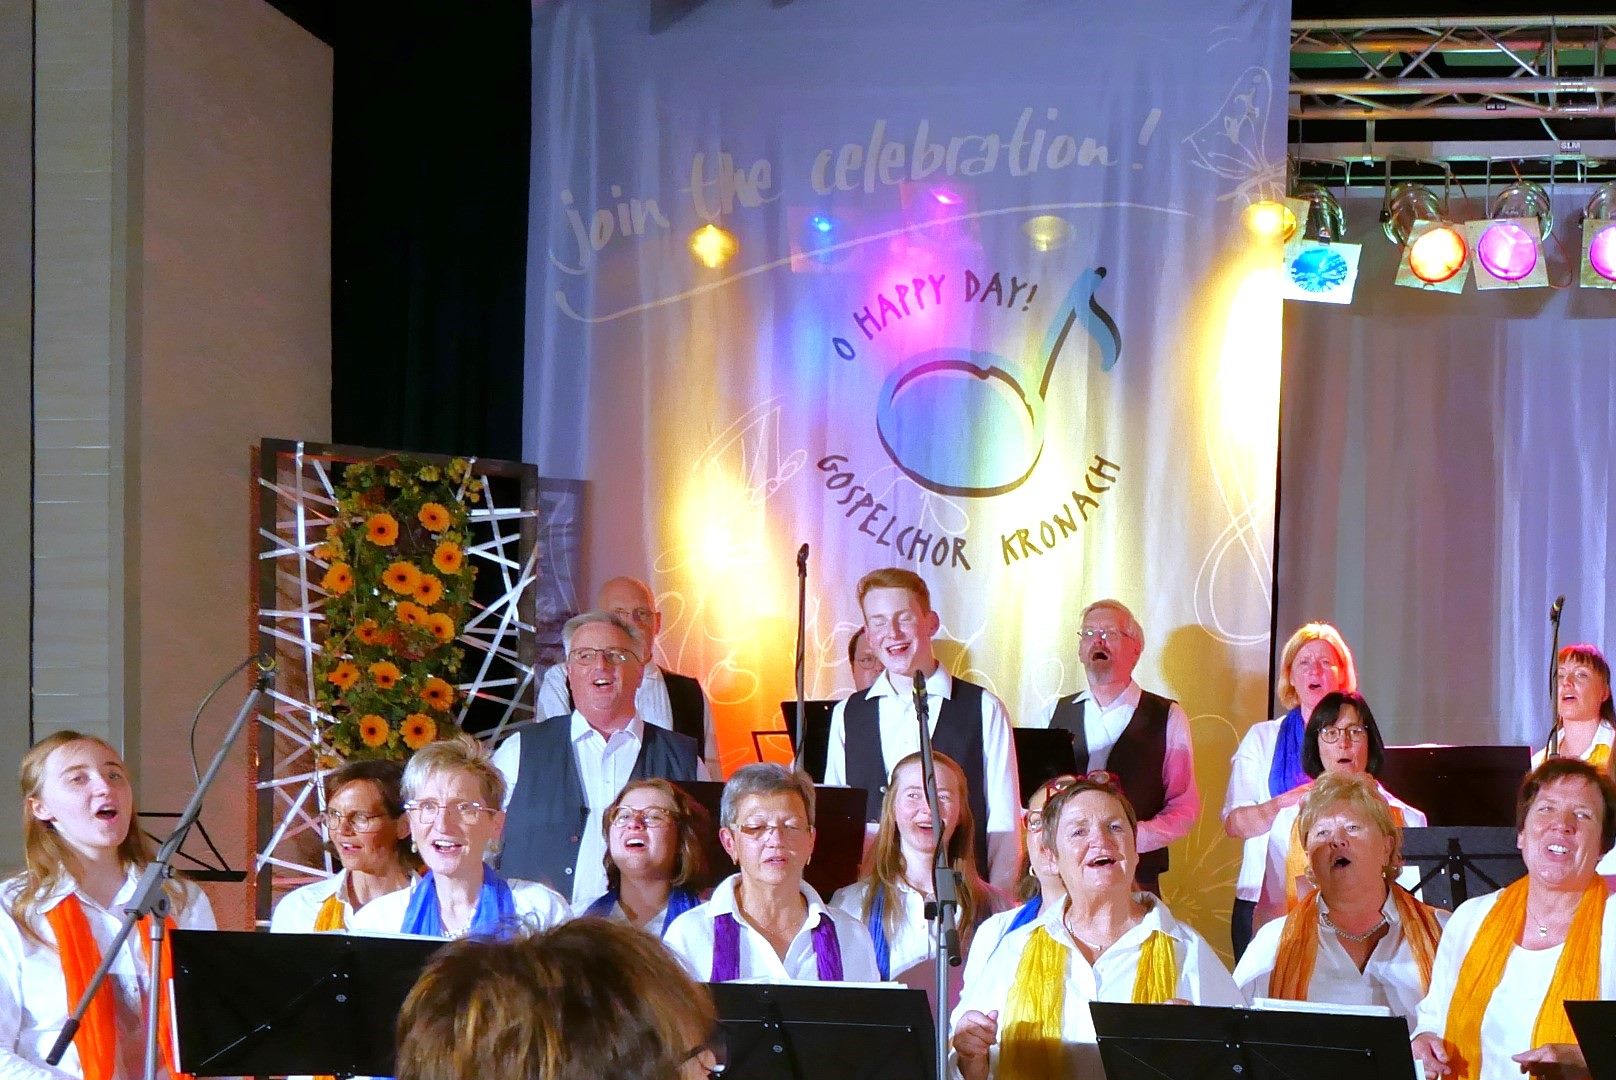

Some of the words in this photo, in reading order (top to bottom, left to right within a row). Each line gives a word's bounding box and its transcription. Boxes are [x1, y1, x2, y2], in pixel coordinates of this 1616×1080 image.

[549, 187, 669, 275] join
[680, 152, 781, 220] the
[832, 336, 857, 361] O
[855, 273, 947, 343] HAPPY
[964, 269, 1040, 312] DAY!
[816, 455, 973, 572] GOSPELCHOR
[999, 455, 1124, 568] KRONACH
